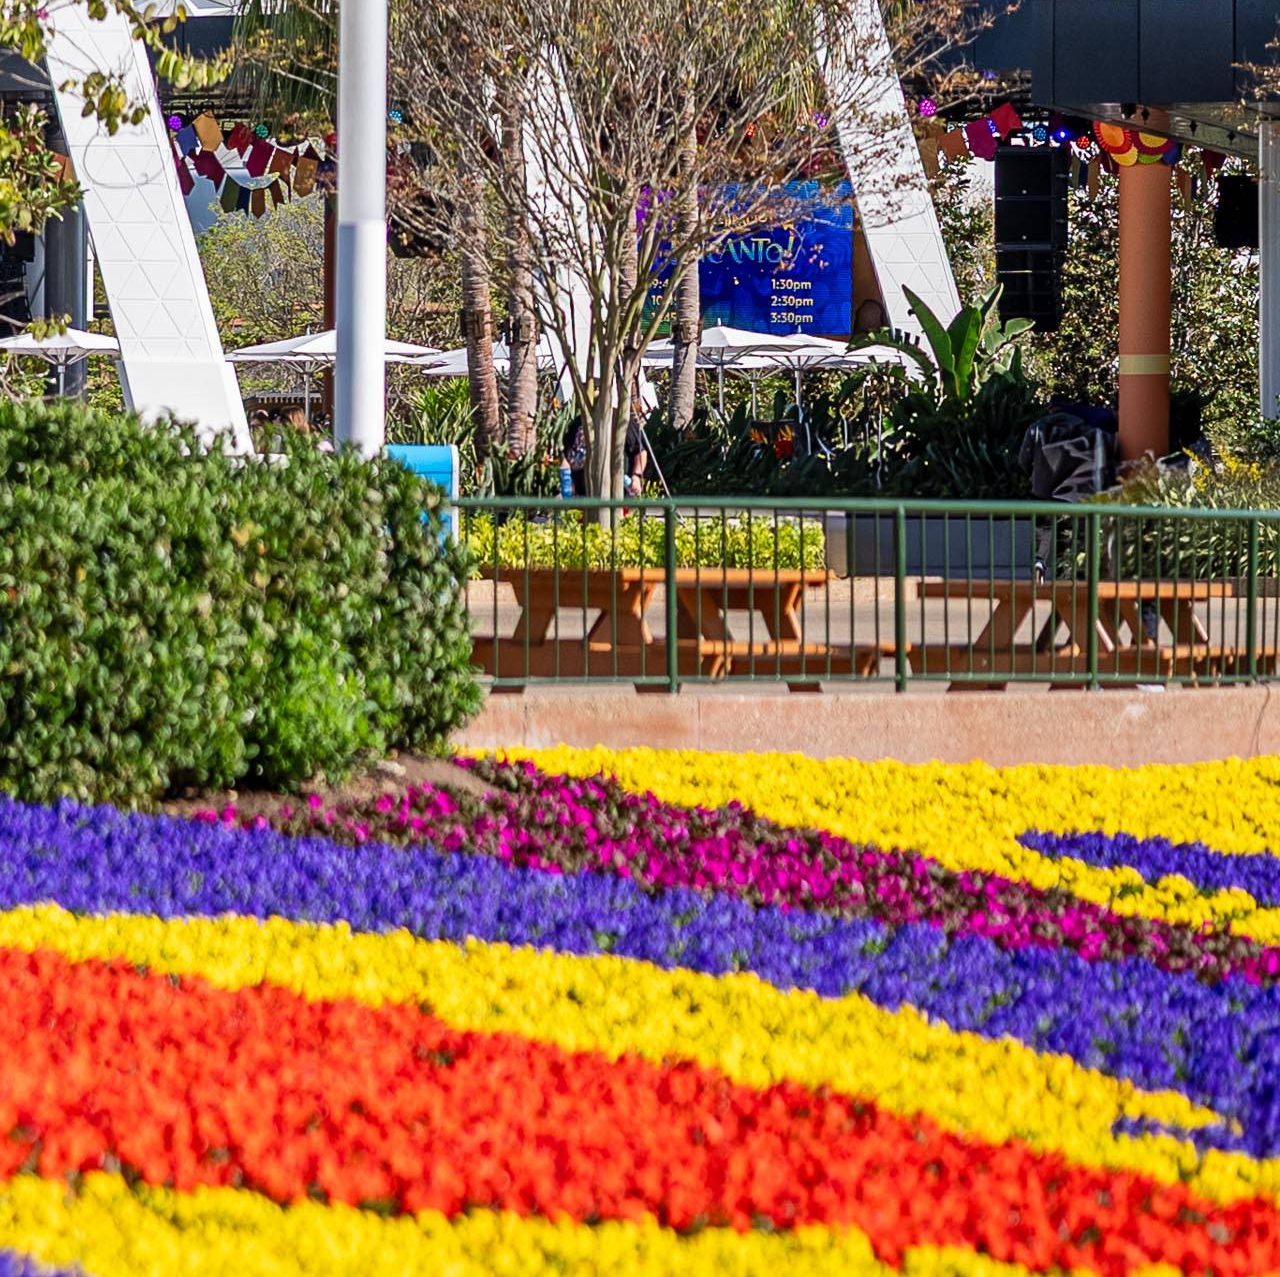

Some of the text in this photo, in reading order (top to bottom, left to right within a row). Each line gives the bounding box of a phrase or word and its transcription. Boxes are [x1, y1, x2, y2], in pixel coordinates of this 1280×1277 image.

[771, 279, 812, 292] 1:30pm
[770, 296, 814, 309] 2:30pm
[770, 312, 813, 326] 3:30pm
